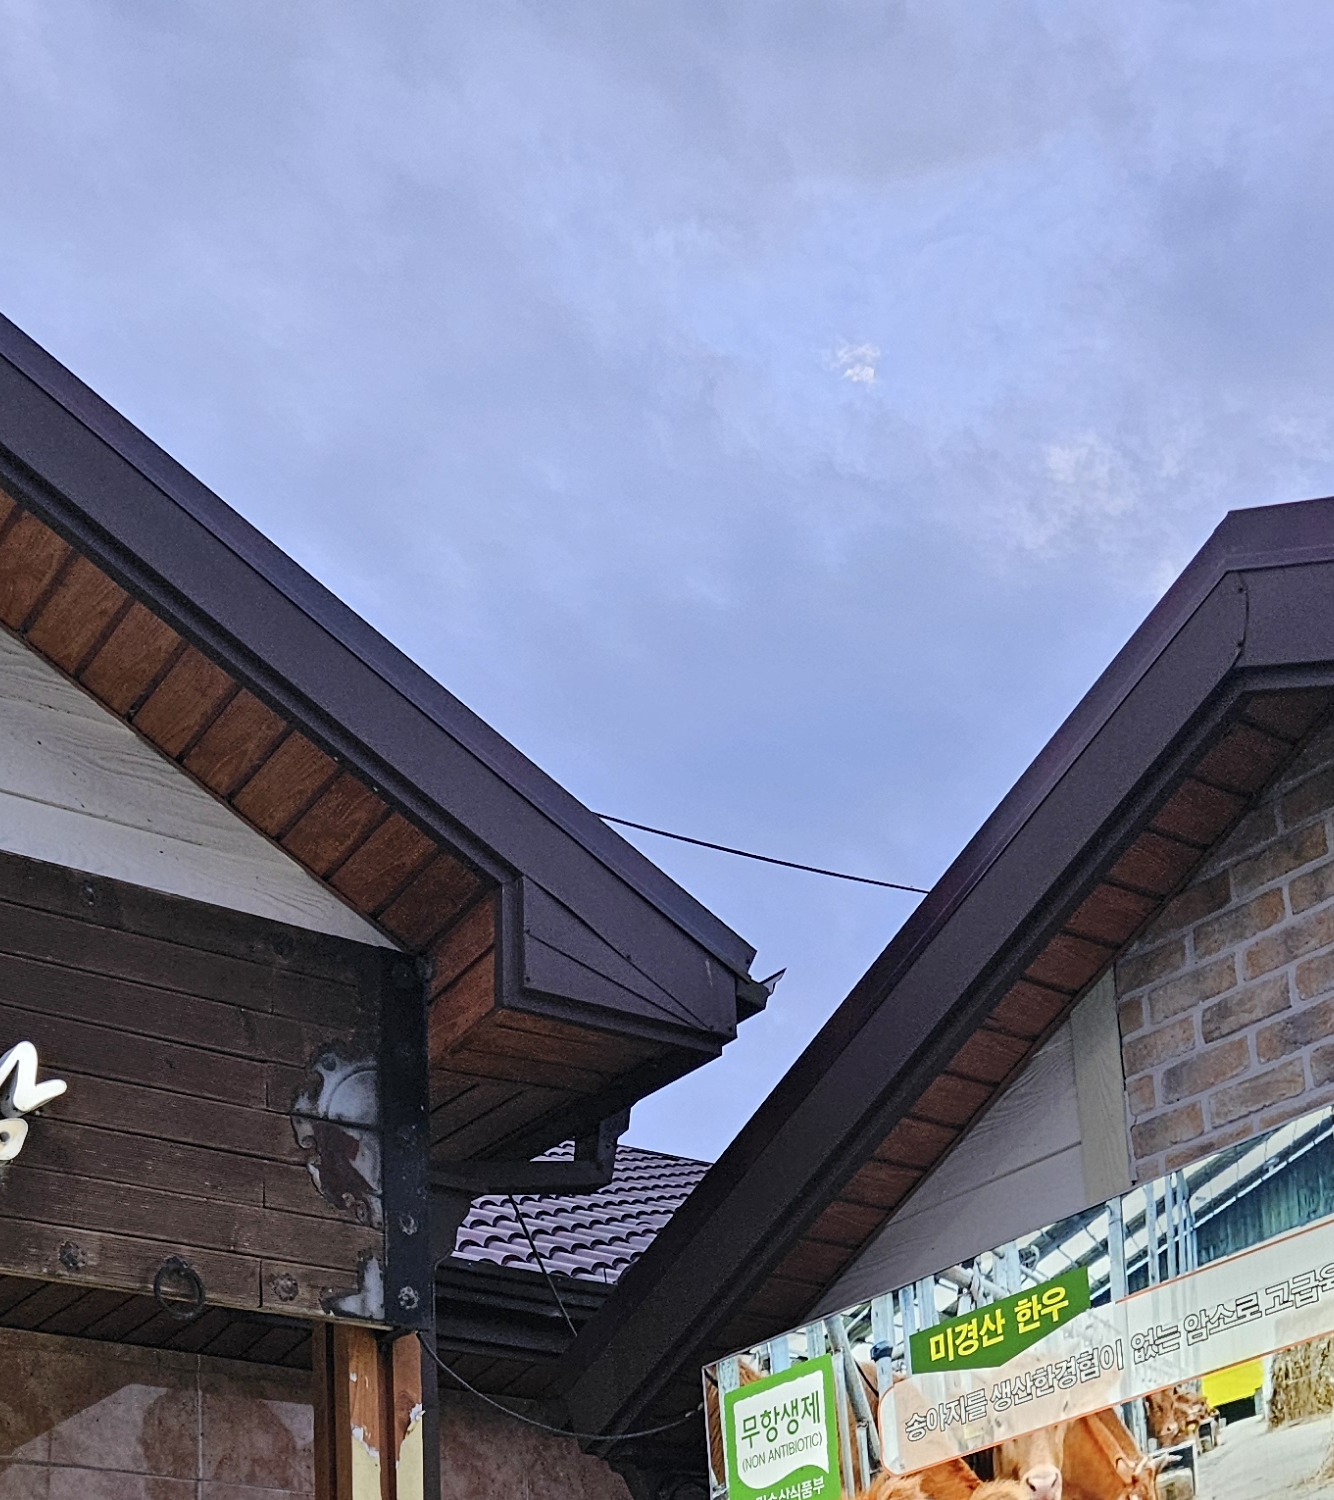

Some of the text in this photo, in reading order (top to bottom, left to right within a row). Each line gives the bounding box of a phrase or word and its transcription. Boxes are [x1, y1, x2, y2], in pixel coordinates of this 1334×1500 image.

[928, 1285, 1070, 1363] 미경산 한우
[903, 1390, 988, 1442] 송아지를
[1130, 1318, 1183, 1367] 없는
[1183, 1284, 1265, 1345] 암소로
[741, 1390, 821, 1449] 무항생제
[742, 1431, 823, 1474] (NON ANTIBIOTIC)
